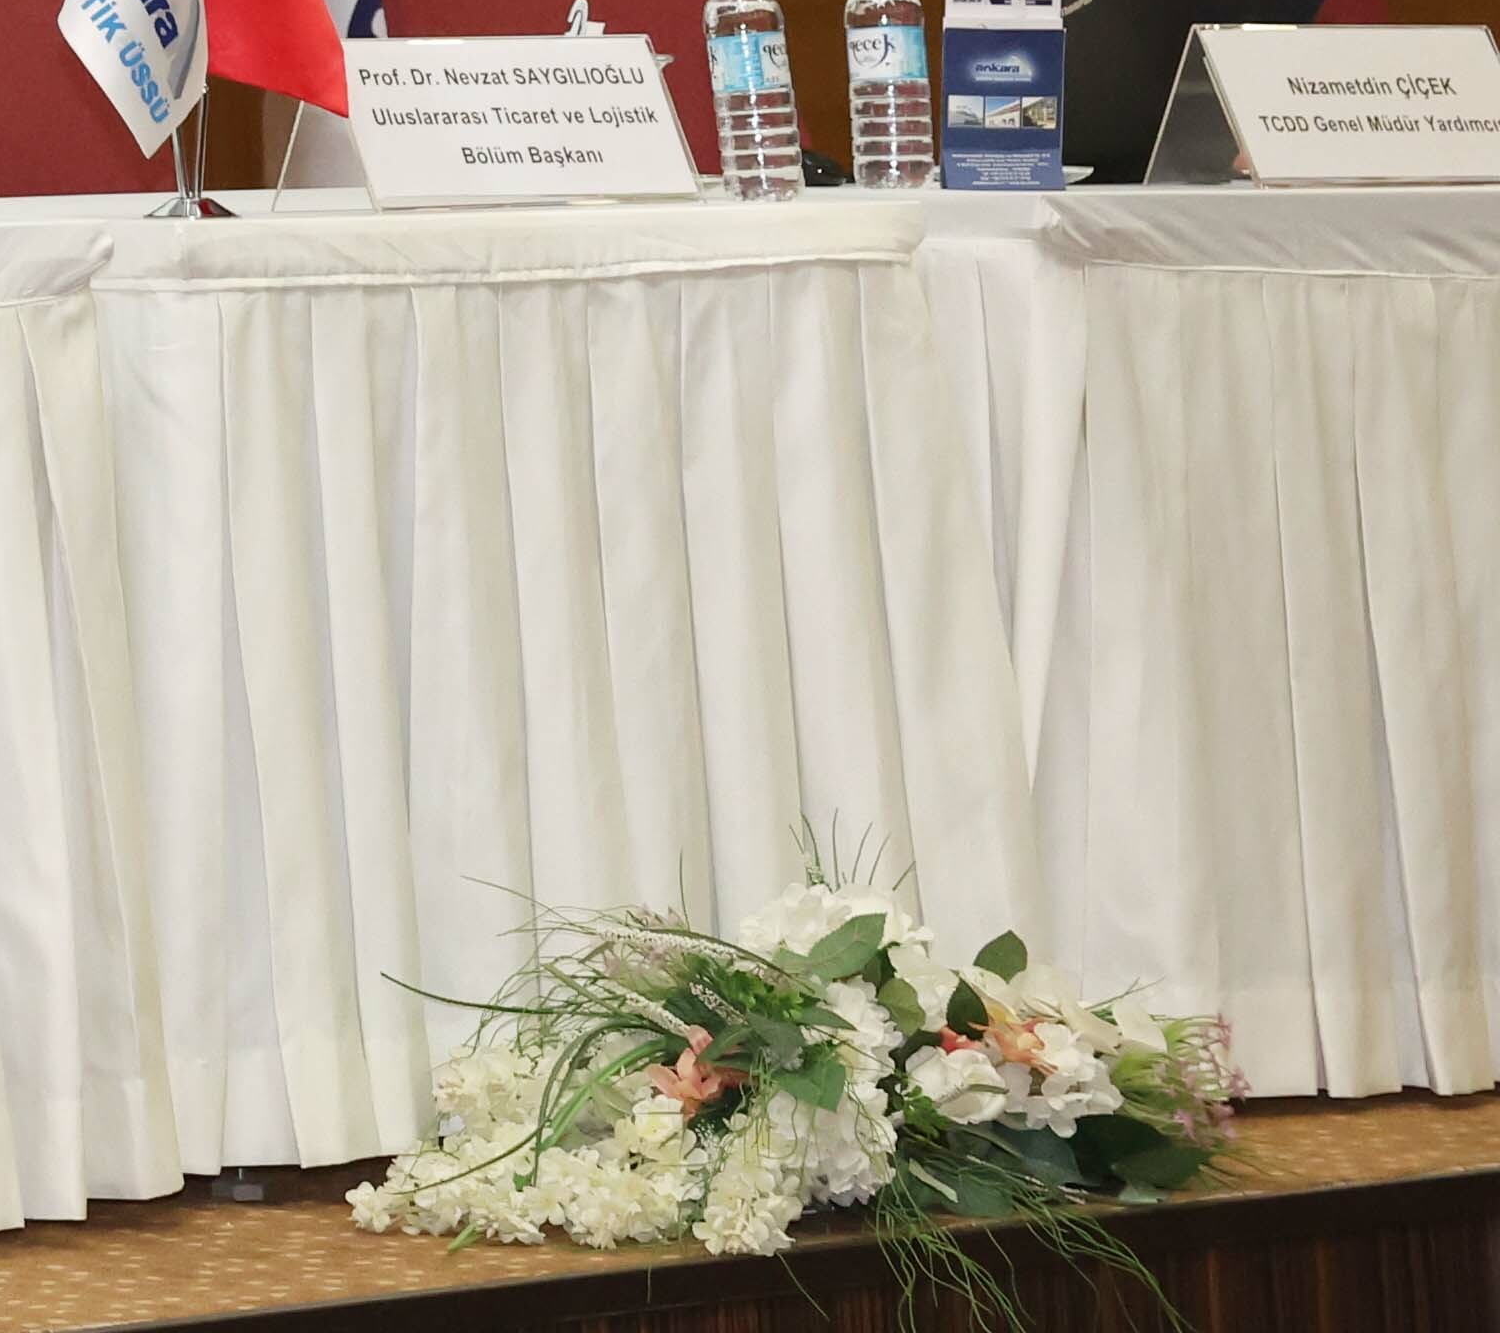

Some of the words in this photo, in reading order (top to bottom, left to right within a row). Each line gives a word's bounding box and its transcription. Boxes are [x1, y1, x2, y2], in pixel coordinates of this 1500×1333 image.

[359, 68, 406, 86] Prof.
[410, 68, 440, 85] Dr.
[444, 68, 509, 85] Nevzat
[513, 64, 646, 85] SAYGILIOĞLU
[1287, 77, 1393, 95] Nizametdin
[1396, 73, 1457, 100] ÇİÇEK
[372, 107, 488, 126] Uluslararası
[491, 107, 559, 125] Ticaret
[563, 110, 584, 124] ve
[589, 106, 659, 128] Lojistik
[1259, 115, 1309, 133] TCDD
[1313, 115, 1364, 133] Genel
[1366, 114, 1420, 133] Müdür
[461, 145, 523, 165] Bölüm
[528, 145, 604, 167] Başkanı
